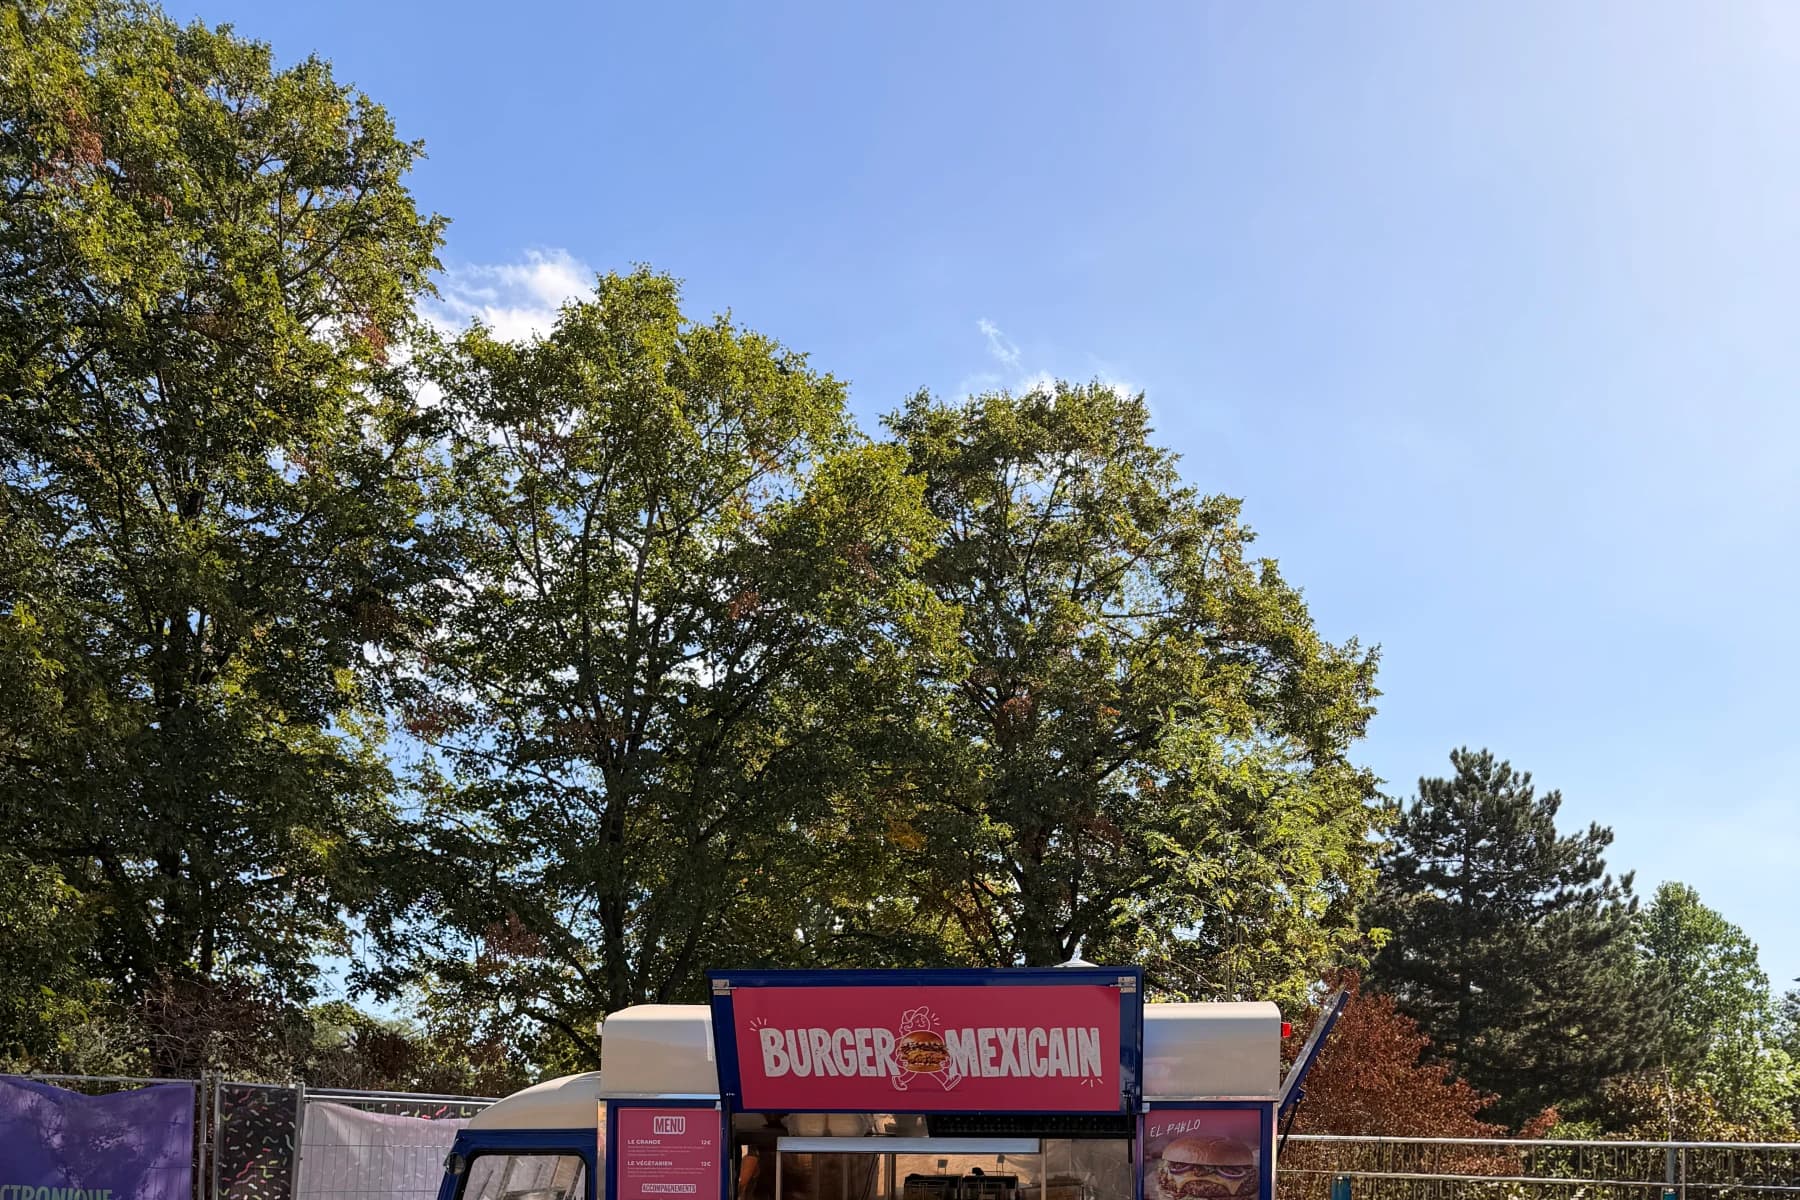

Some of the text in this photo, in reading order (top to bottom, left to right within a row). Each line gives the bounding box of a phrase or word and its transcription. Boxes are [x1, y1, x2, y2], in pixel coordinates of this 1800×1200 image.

[759, 1027, 1102, 1078] BURGER MEXICAIN
[655, 1117, 684, 1133] MENU
[1151, 1124, 1163, 1137] EL
